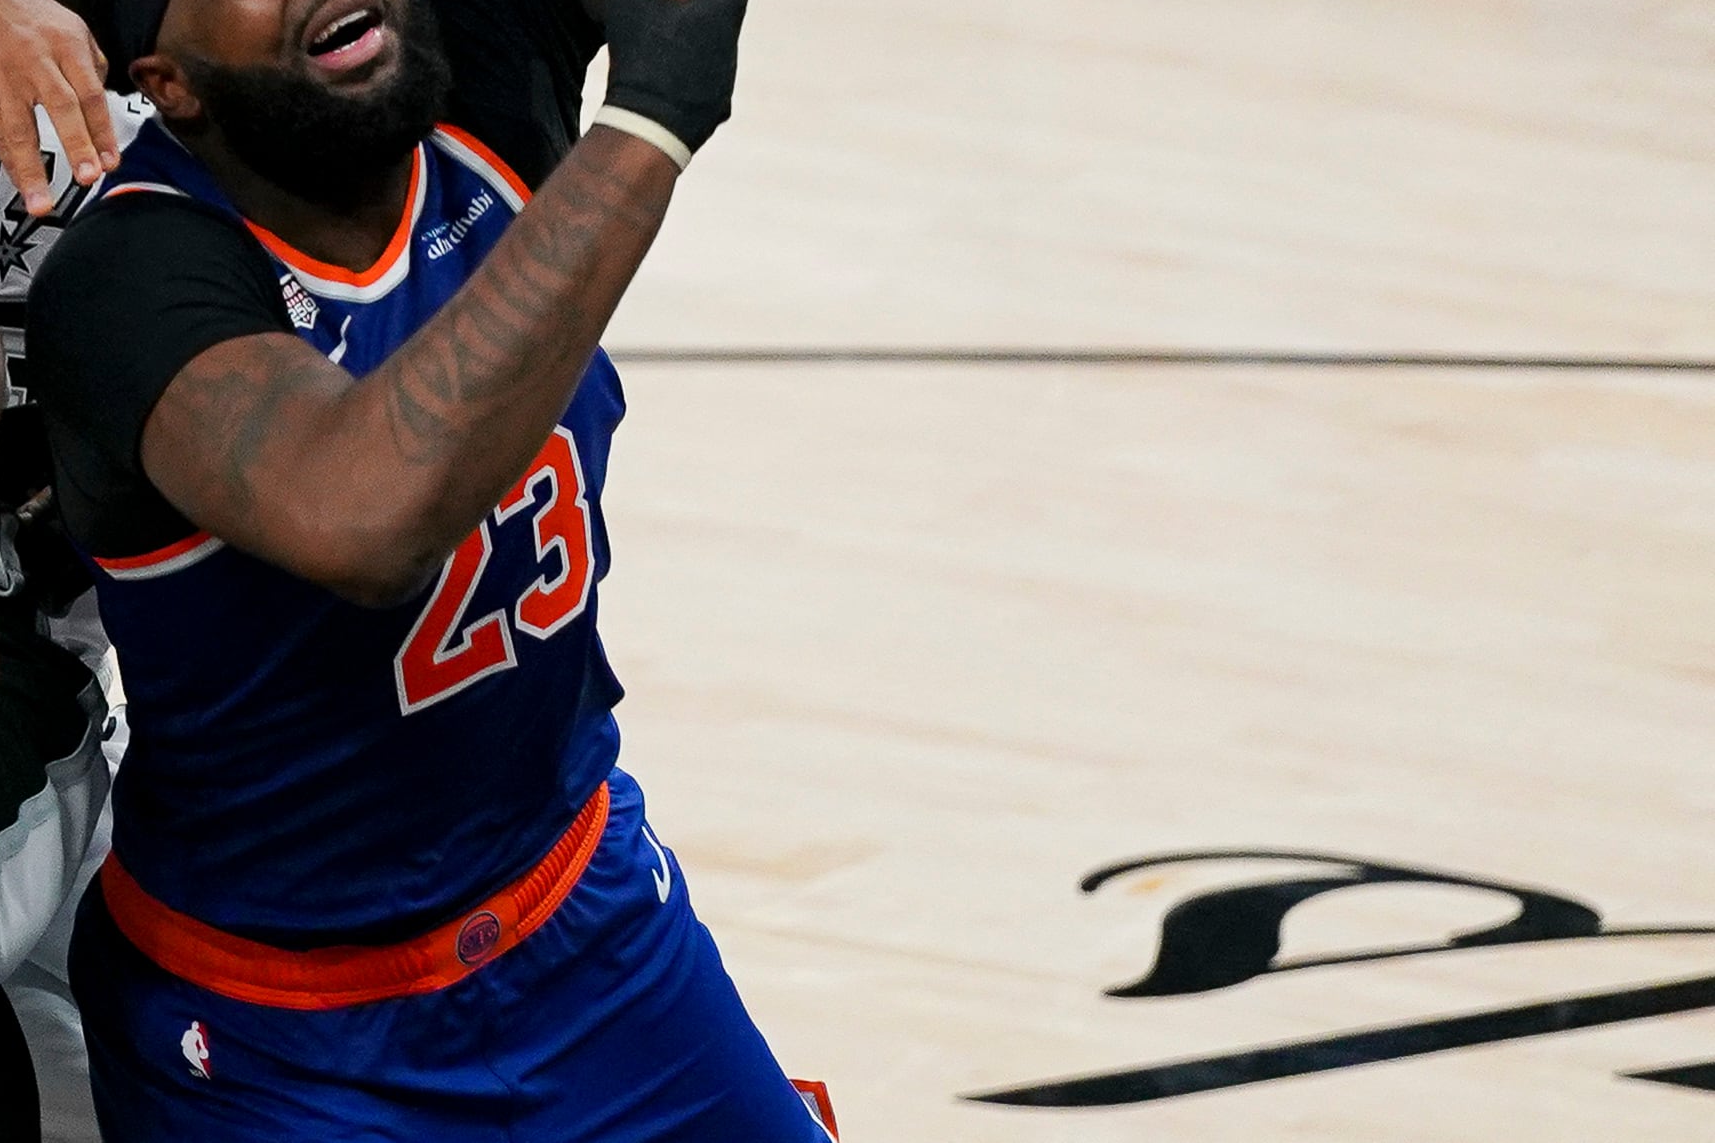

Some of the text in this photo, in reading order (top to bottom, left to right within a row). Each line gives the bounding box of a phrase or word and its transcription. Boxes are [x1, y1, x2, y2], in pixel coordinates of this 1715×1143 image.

[427, 236, 454, 260] abu
[449, 188, 494, 244] dhabi
[287, 296, 317, 323] 250
[394, 423, 595, 716] 23
